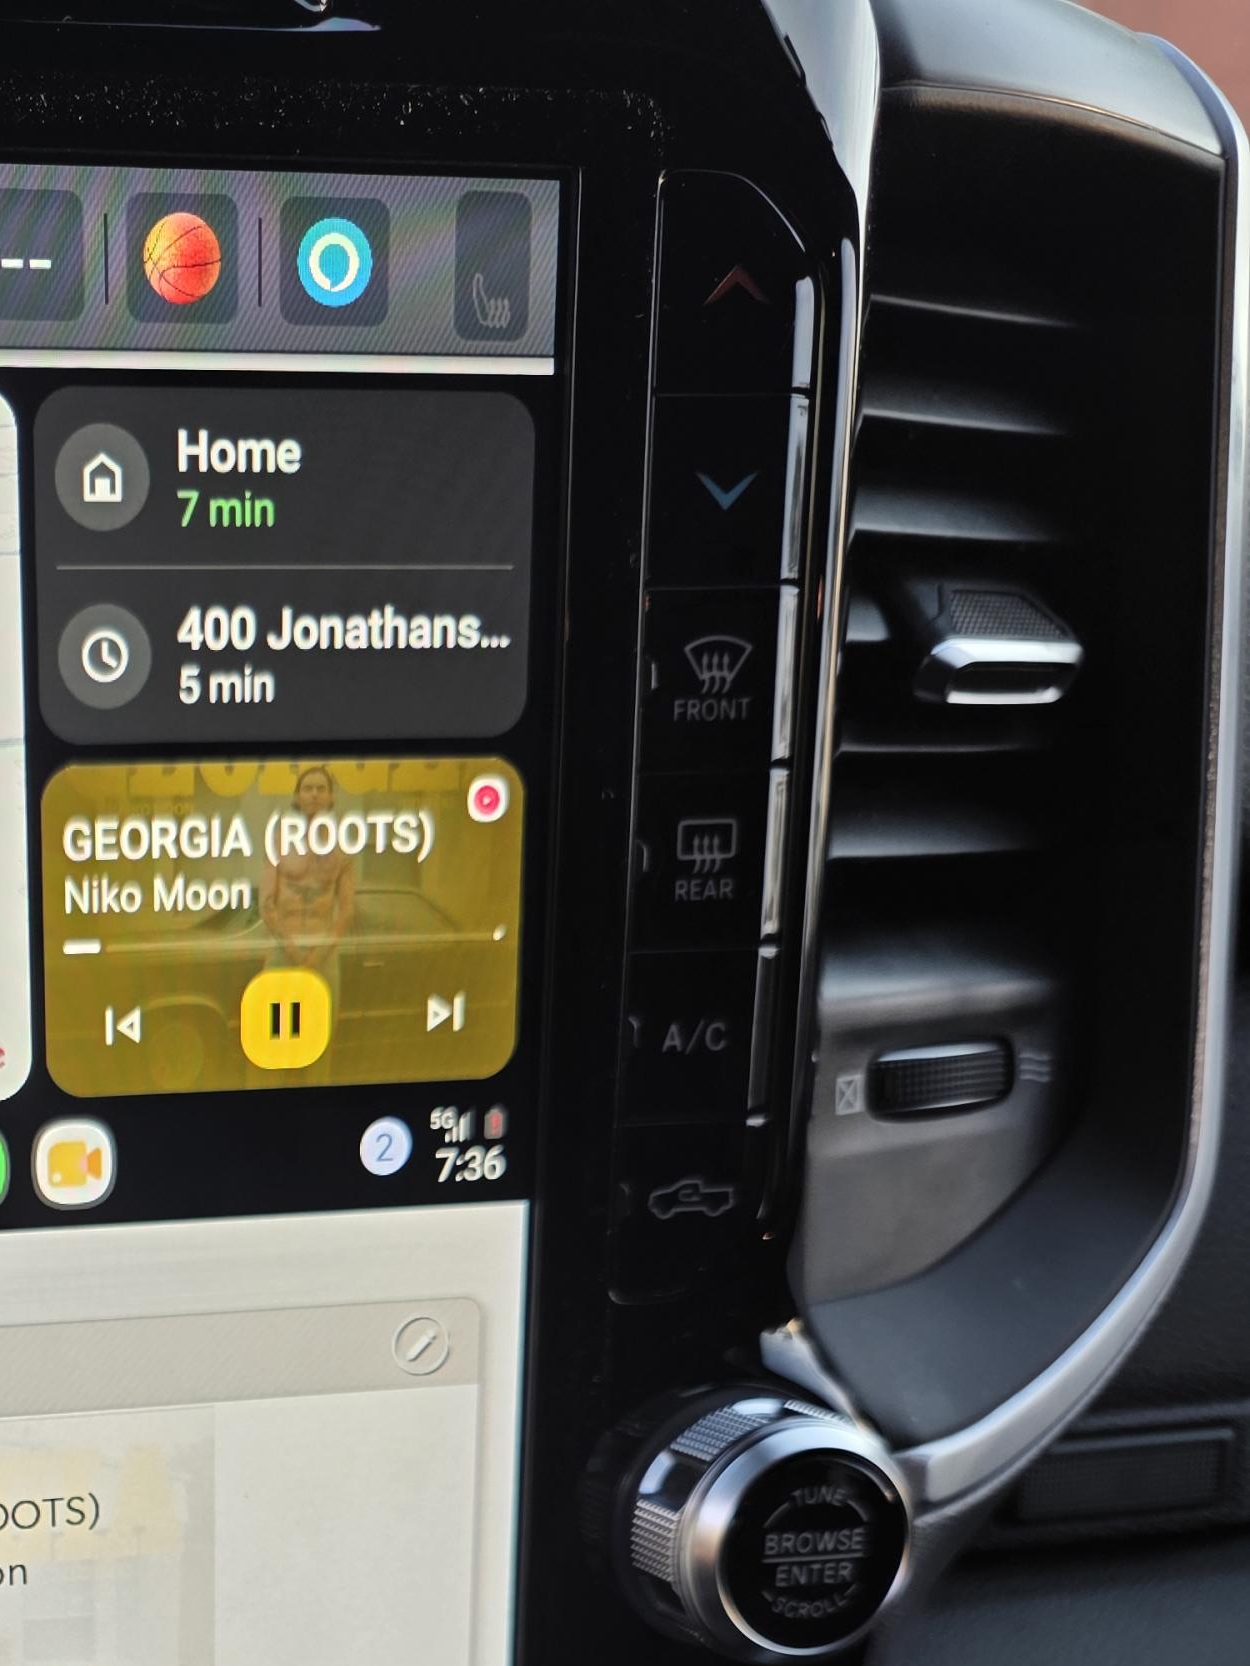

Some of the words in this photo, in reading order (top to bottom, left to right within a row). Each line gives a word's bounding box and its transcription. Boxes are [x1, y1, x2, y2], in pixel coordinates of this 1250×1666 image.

[177, 428, 302, 474] Home
[177, 490, 199, 528] 7
[209, 489, 275, 528] min
[177, 605, 257, 651] 400
[267, 604, 511, 650] Jonathans...
[179, 664, 201, 704] 5
[209, 665, 275, 704] min
[674, 698, 750, 722] FRONT
[63, 811, 252, 862] GEORGIA
[265, 809, 435, 868] (ROOTS)
[63, 875, 143, 914] Niko
[153, 873, 252, 913] Moon
[674, 879, 734, 901] REAR
[661, 1019, 728, 1054] A/C
[430, 1105, 459, 1130] 5G
[375, 1133, 393, 1162] 2
[435, 1144, 508, 1183] 7:36
[791, 1485, 848, 1507] TUNE
[764, 1527, 865, 1556] BROWSE
[775, 1562, 852, 1588] ENTER
